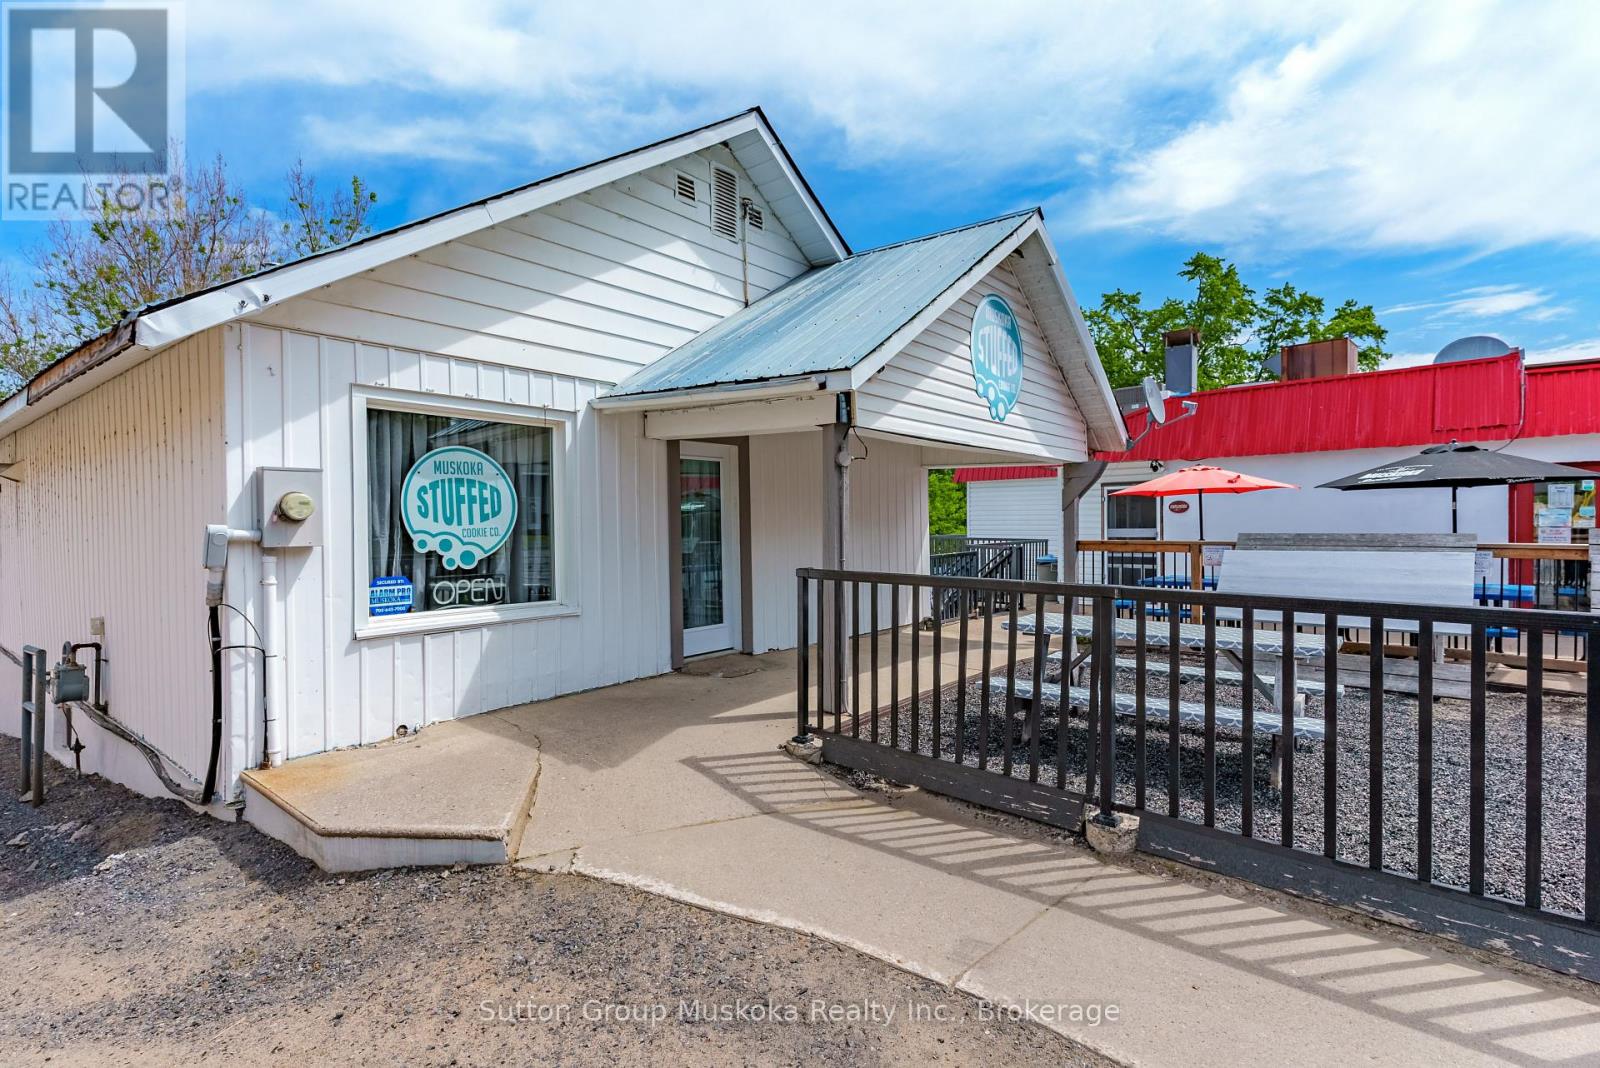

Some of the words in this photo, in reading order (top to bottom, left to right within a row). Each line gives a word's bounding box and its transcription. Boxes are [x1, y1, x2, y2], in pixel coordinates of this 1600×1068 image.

[434, 460, 484, 476] MUSKOKA
[416, 477, 502, 526] STUFFED
[462, 528, 487, 538] COOKIE
[490, 527, 501, 537] CO.
[370, 588, 395, 597] ALARM
[397, 587, 411, 596] PRO
[433, 578, 504, 605] OPEN
